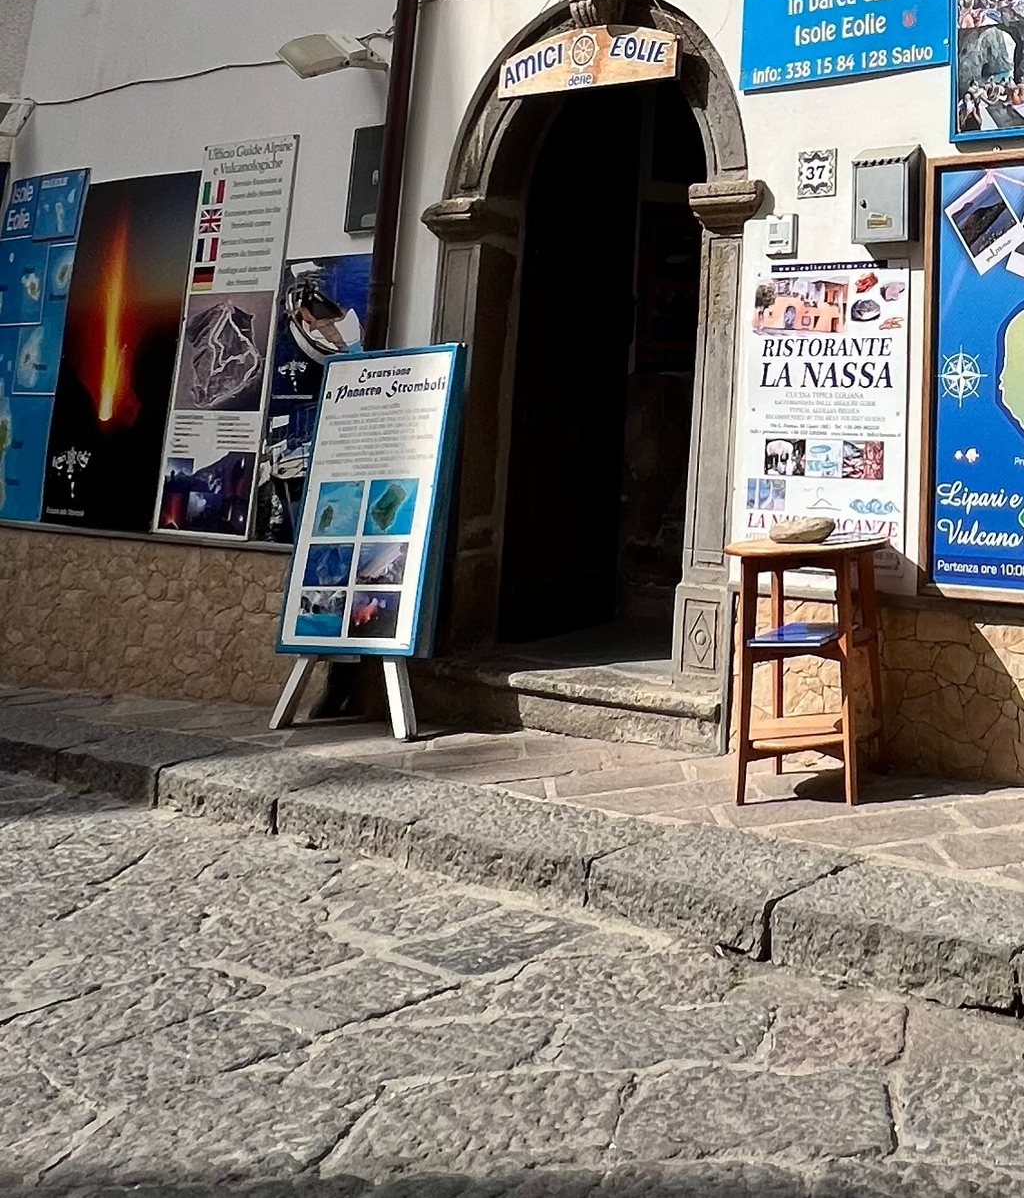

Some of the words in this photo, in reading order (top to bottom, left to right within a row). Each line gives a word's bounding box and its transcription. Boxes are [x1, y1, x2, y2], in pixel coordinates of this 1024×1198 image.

[794, 21, 836, 46] Isole
[841, 13, 887, 38] Eolie
[505, 43, 563, 88] AMICI
[610, 36, 670, 62] EOLIE
[752, 66, 782, 84] info:
[785, 61, 811, 79] 338
[816, 57, 833, 74] 15
[836, 54, 855, 72] 84
[862, 50, 887, 68] 128
[892, 44, 933, 64] Salvo
[236, 144, 263, 158] Guide
[213, 166, 219, 175] e
[805, 164, 827, 181] 37
[12, 181, 34, 204] Isole
[6, 207, 31, 232] Eolie
[762, 337, 893, 357] RISTORANTE
[760, 362, 792, 388] LA
[800, 362, 893, 388] NASSA
[385, 376, 447, 398] Stromboli
[937, 480, 1008, 515] Lipari
[1010, 493, 1023, 508] e
[834, 518, 899, 538] ACANZE
[937, 518, 1024, 547] Vulcano
[937, 559, 979, 573] Partenza
[981, 565, 998, 574] ore
